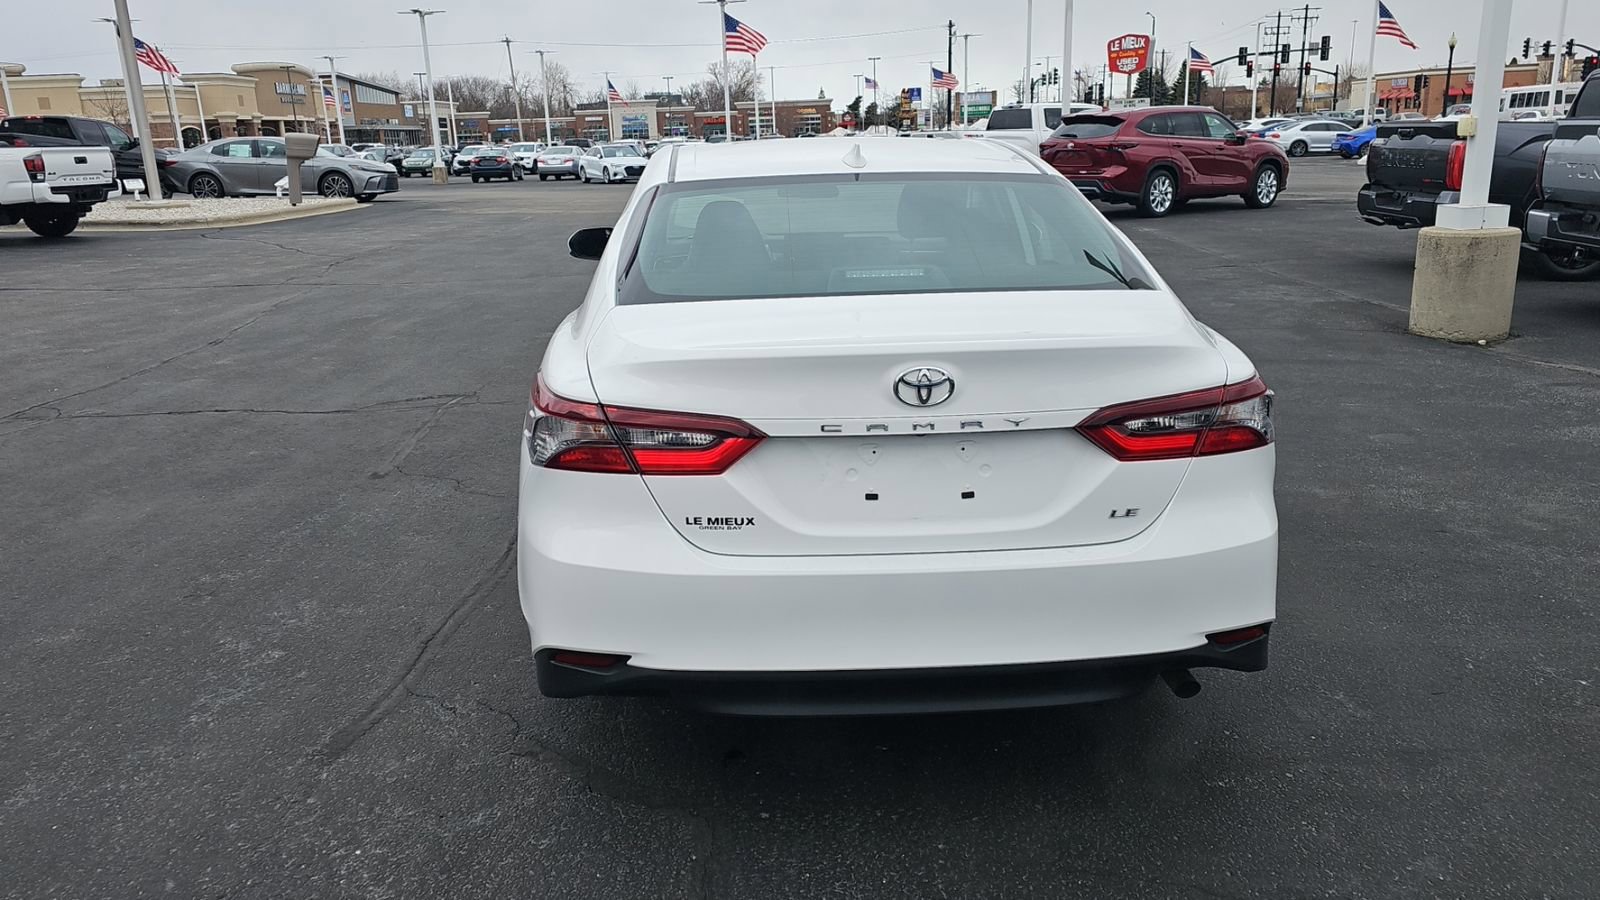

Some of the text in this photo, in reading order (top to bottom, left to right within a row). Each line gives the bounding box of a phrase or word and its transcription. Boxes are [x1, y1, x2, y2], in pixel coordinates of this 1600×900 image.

[1110, 37, 1146, 51] LE MIEUX
[1116, 57, 1139, 65] USED
[1118, 64, 1137, 72] CARS
[820, 416, 1031, 433] CAMRY
[1108, 507, 1141, 519] LE
[685, 516, 756, 526] LE MIEUX
